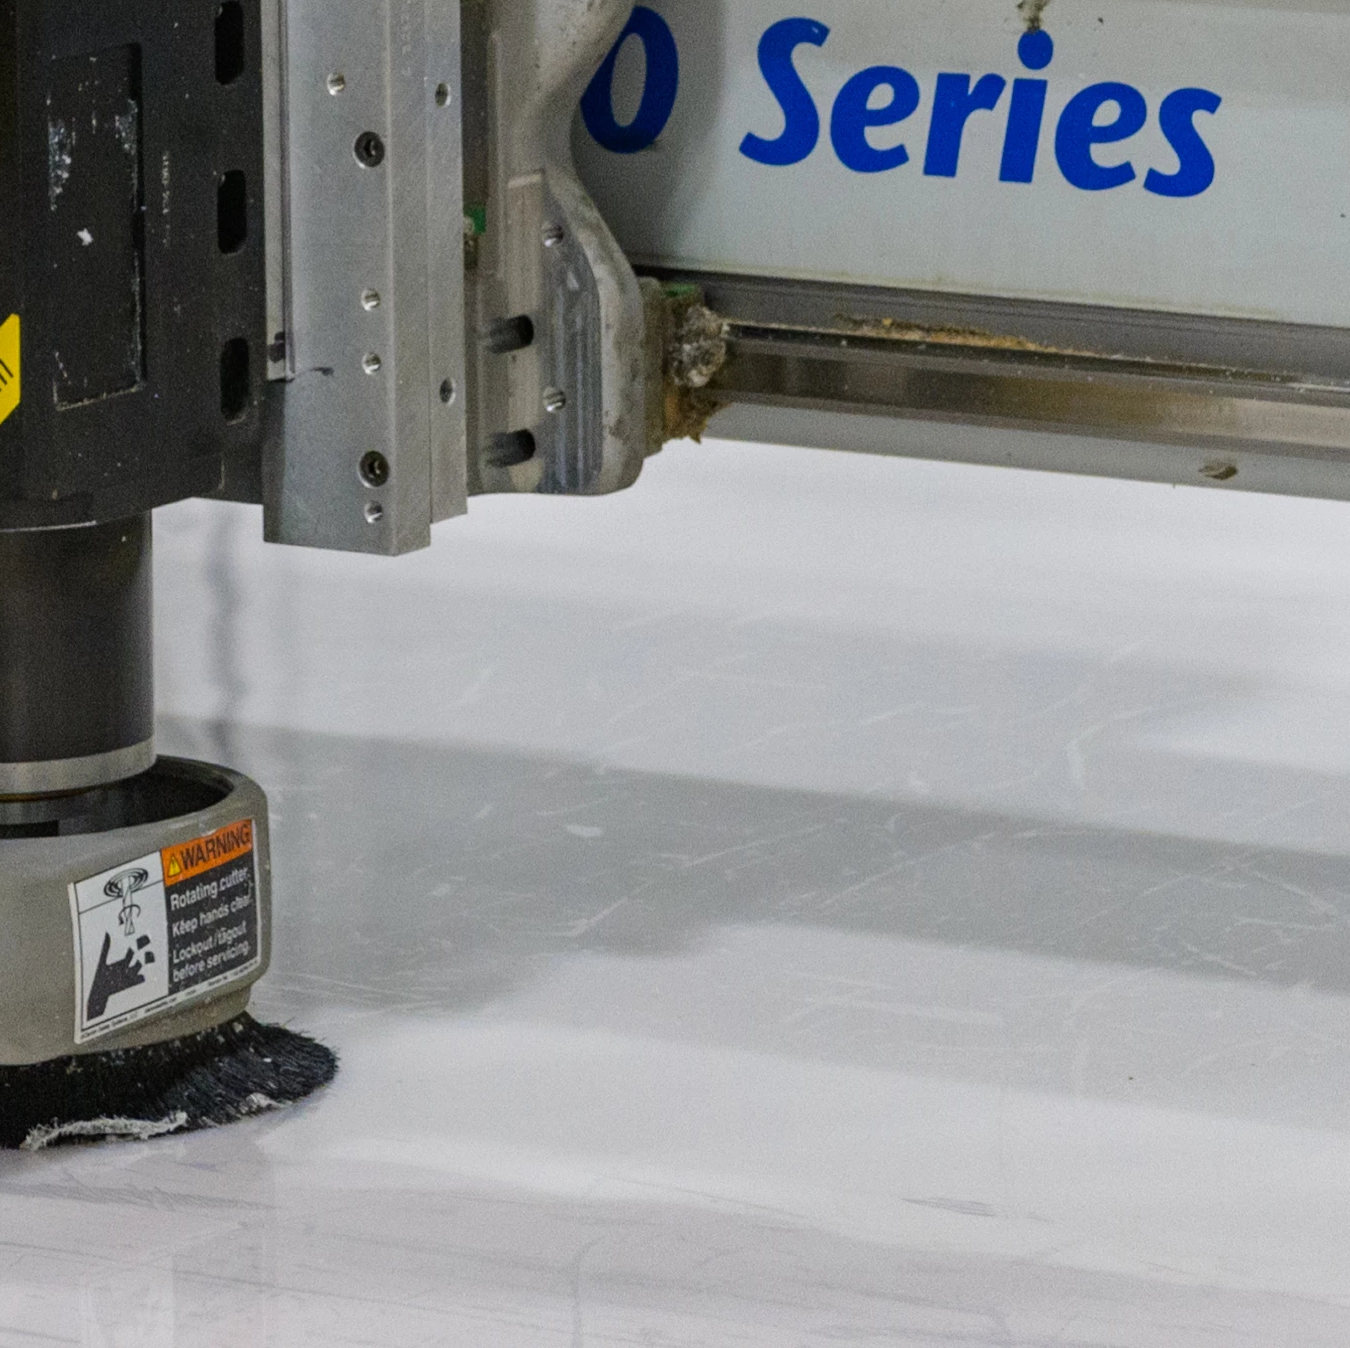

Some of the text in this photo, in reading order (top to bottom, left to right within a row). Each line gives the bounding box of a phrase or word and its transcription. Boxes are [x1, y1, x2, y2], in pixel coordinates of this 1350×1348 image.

[737, 16, 1223, 198] Series
[179, 824, 250, 870] WARNING
[170, 881, 219, 911] Rotating
[172, 917, 198, 937] Keep
[199, 903, 230, 927] hands
[172, 960, 206, 983] before
